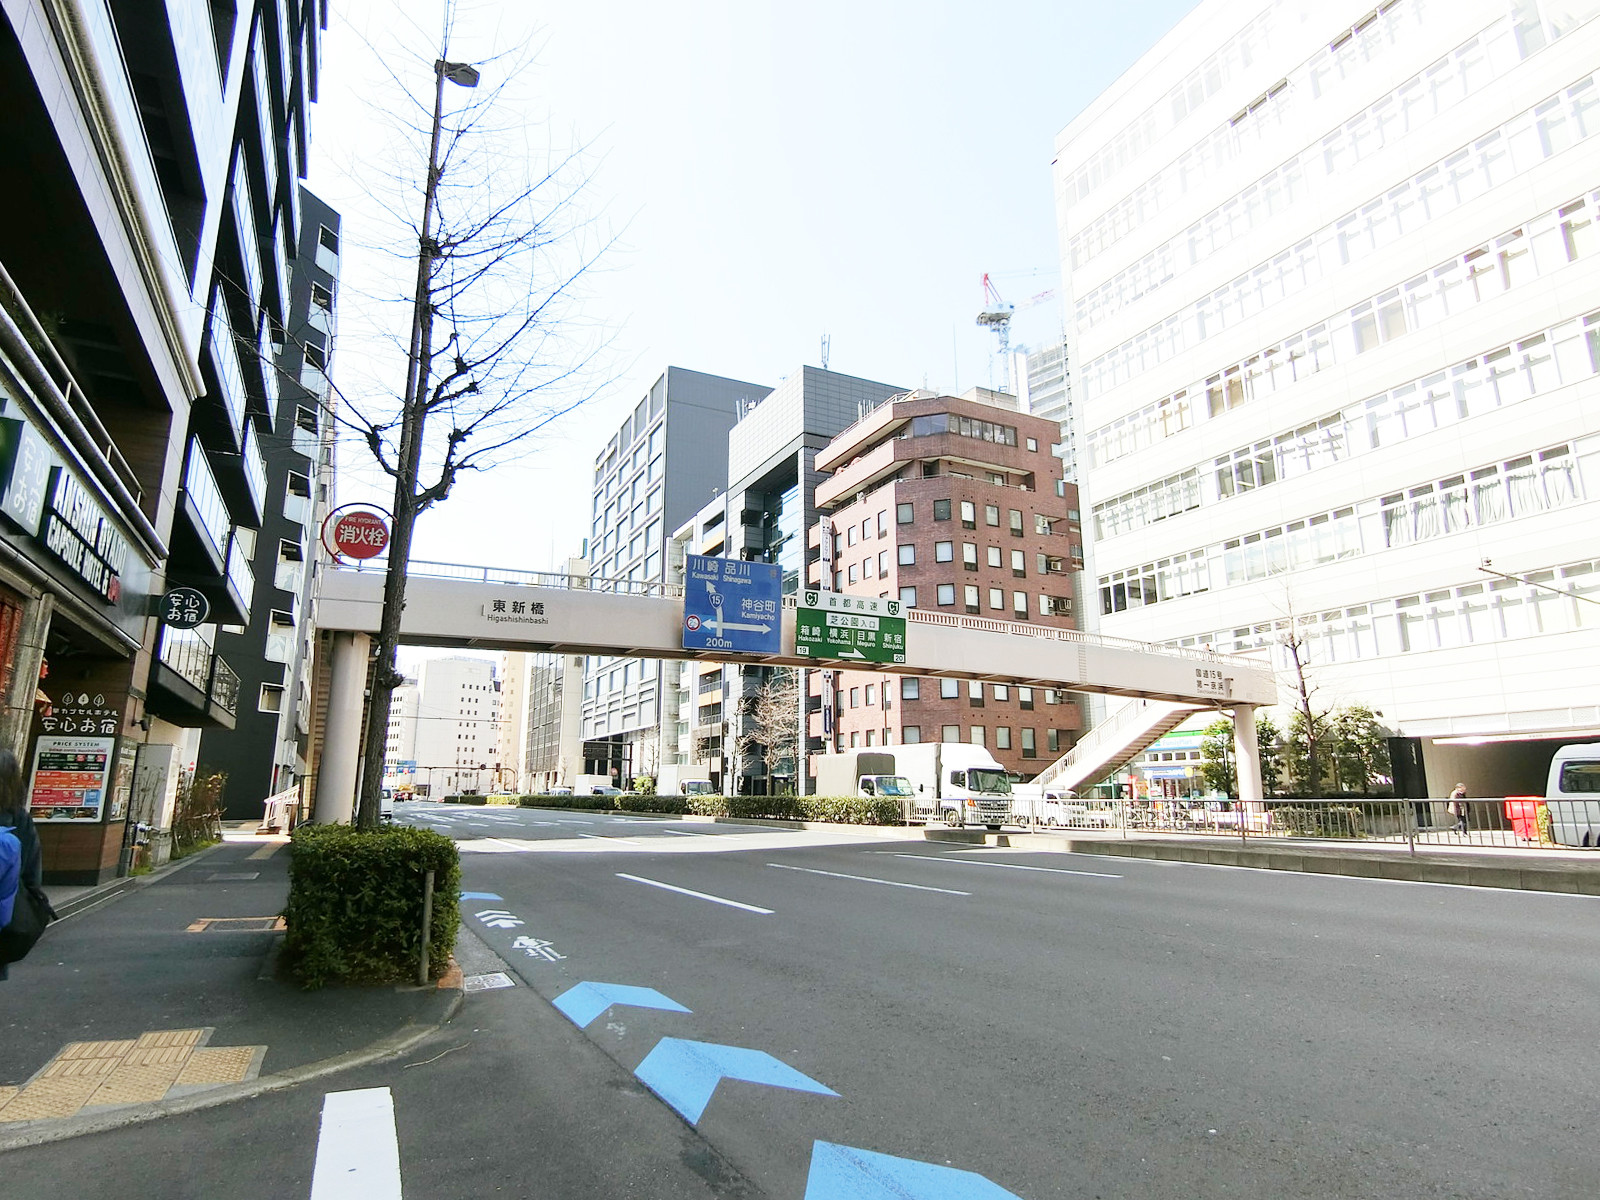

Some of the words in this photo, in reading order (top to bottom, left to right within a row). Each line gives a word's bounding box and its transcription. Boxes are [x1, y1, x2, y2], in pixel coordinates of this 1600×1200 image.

[52, 468, 101, 549] ANSHIN
[97, 518, 128, 577] OYADO
[344, 516, 357, 524] FIRE
[357, 517, 383, 526] HYDRANT
[338, 524, 386, 547] 消火栓
[46, 514, 85, 561] CAPSULE
[81, 550, 104, 591] HOTEL
[101, 569, 109, 596] &
[693, 558, 719, 573] 川崎
[725, 562, 751, 576] 品川
[692, 572, 719, 581] Kawasaki
[723, 575, 752, 584] Shinagawa
[170, 593, 200, 608] 安心
[492, 599, 545, 615] 東新橋
[711, 595, 721, 604] 15
[741, 598, 776, 613] 神谷町
[829, 597, 878, 611] 首都高速
[167, 607, 199, 622] お宿
[487, 613, 549, 625] Higashishinbashi
[741, 611, 775, 621] Kamiyacho
[800, 625, 821, 637] 箱崎
[829, 627, 849, 639] 横浜
[857, 631, 876, 642] 目黒
[883, 633, 903, 644] 新宿
[706, 637, 733, 648] 200m
[798, 635, 823, 643] Hakozaki
[827, 637, 852, 645] Yokohama
[882, 642, 904, 650] Shinjuku
[41, 716, 118, 734] 安心お宿
